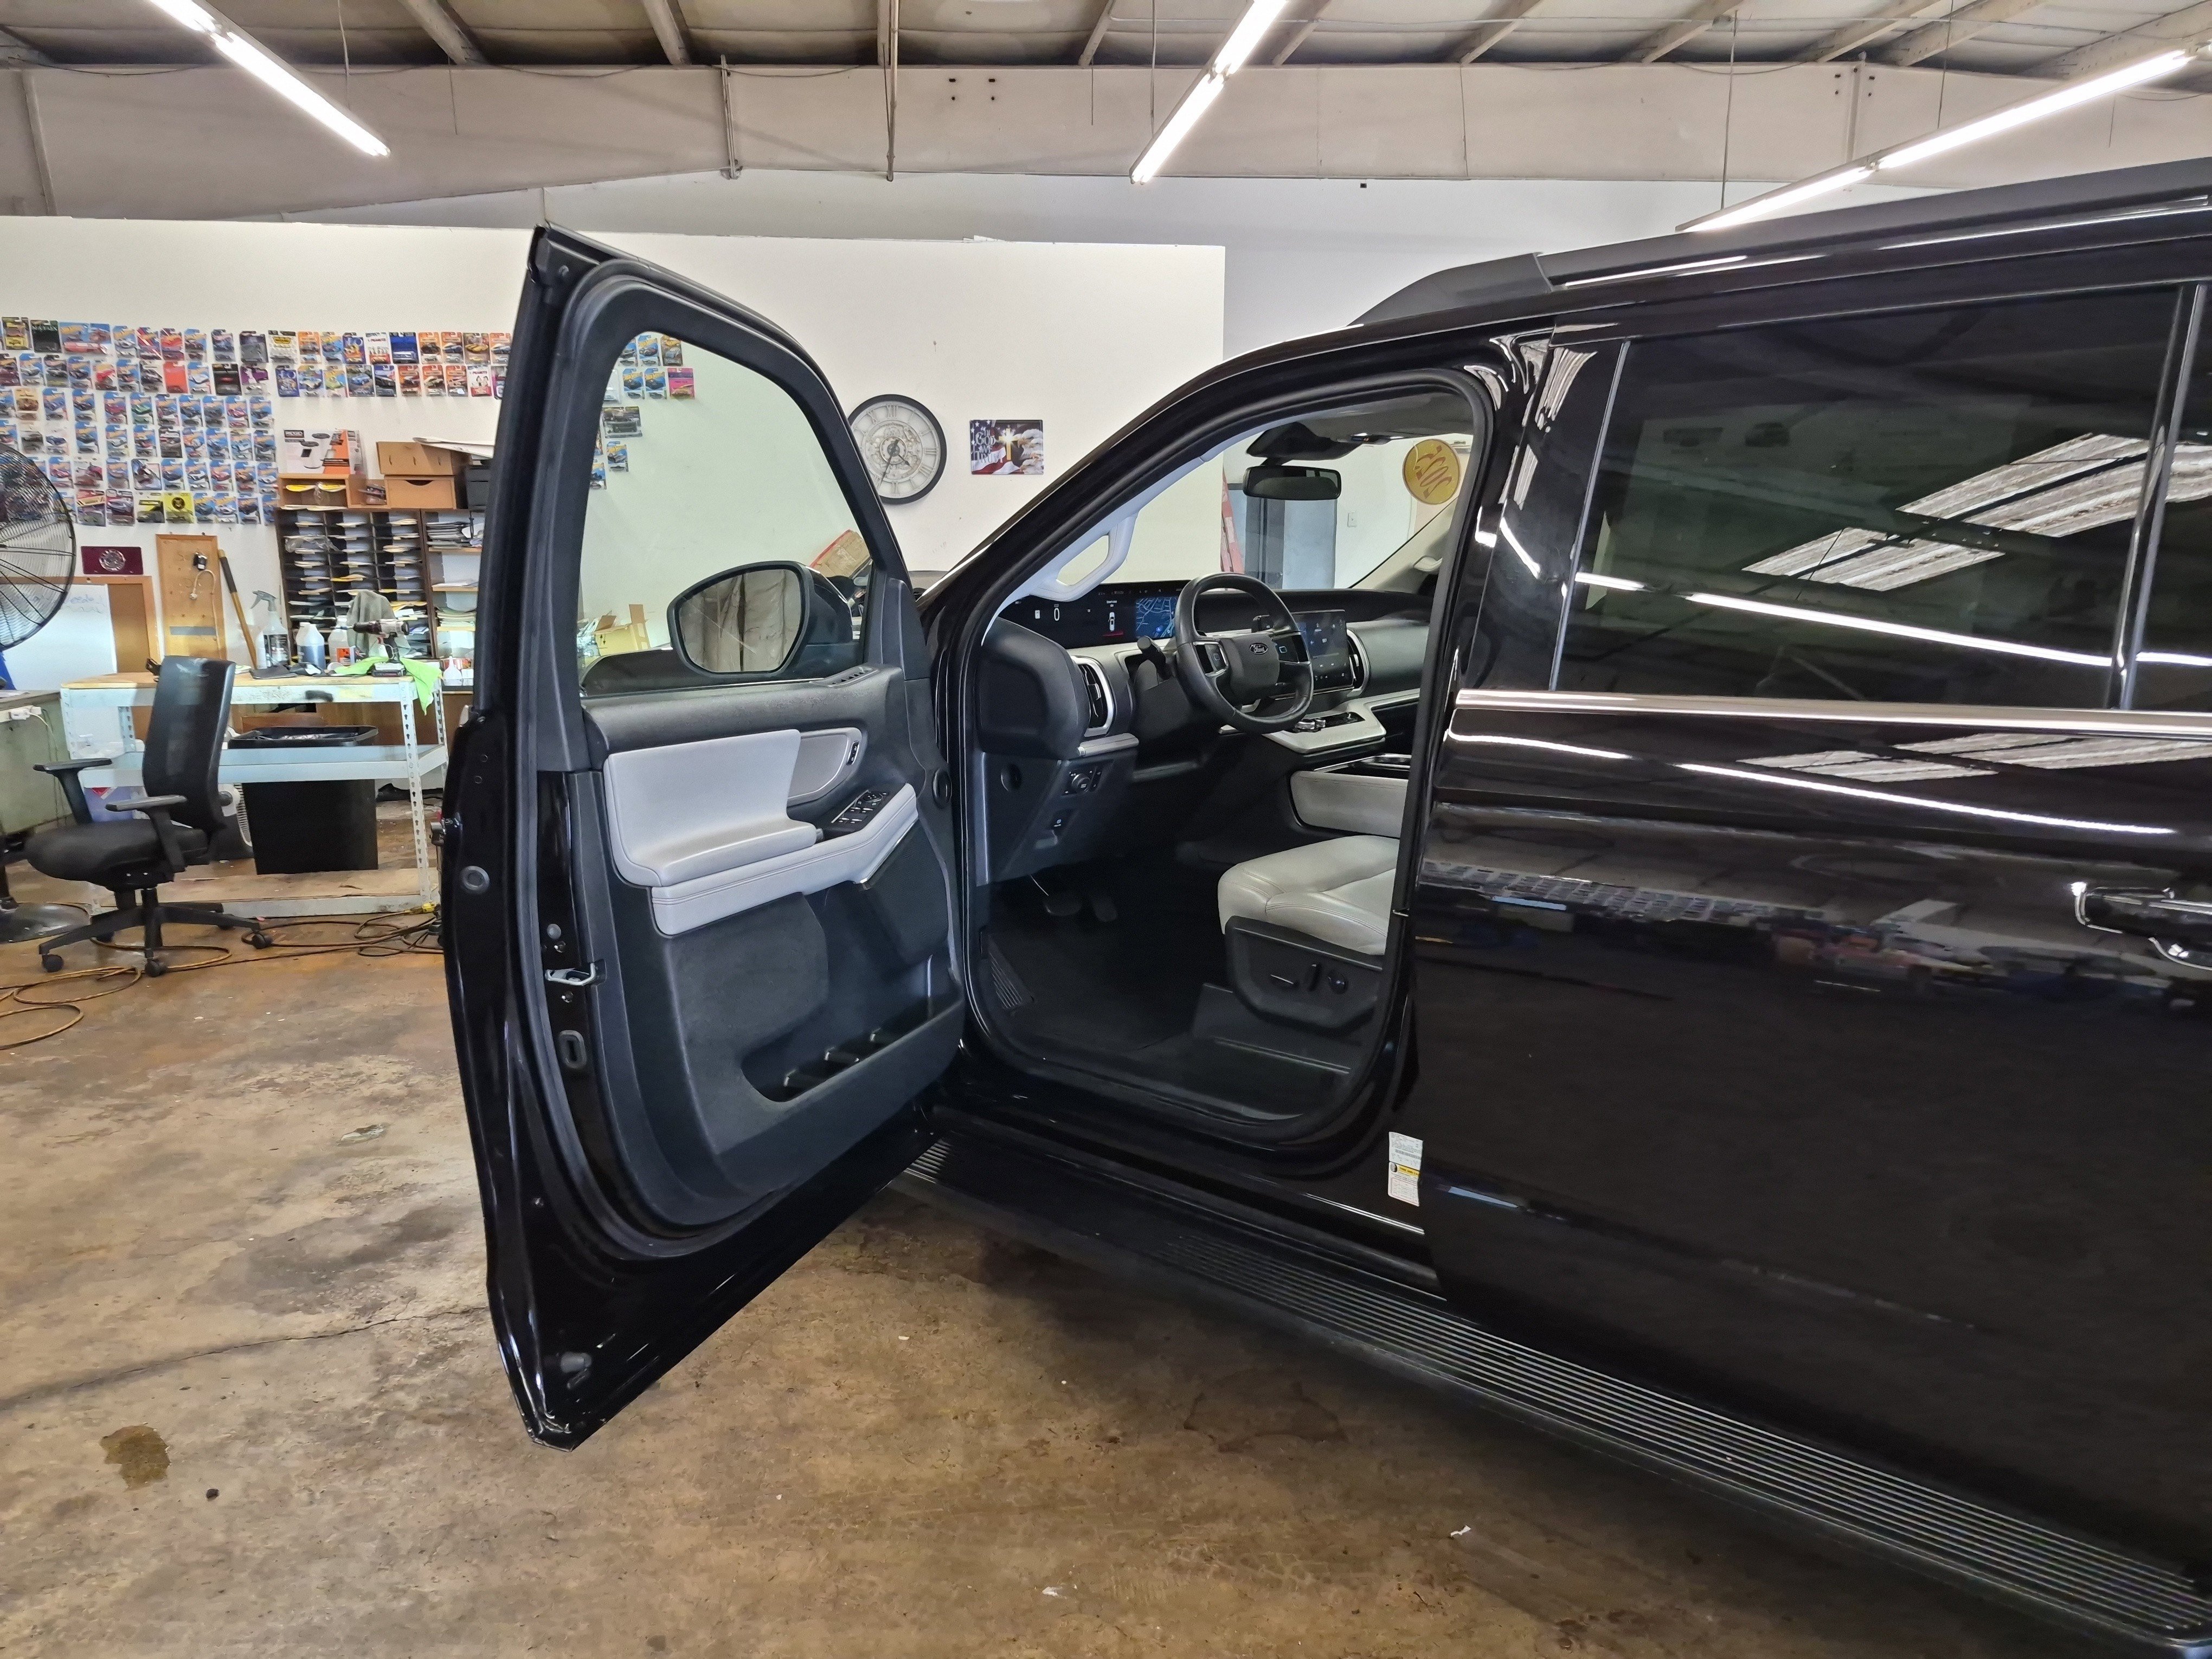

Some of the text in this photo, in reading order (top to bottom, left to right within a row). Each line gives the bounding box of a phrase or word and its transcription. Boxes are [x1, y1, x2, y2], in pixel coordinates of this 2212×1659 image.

[975, 432, 996, 445] GOD
[975, 451, 1003, 464] TRUST
[1054, 608, 1059, 621] 0
